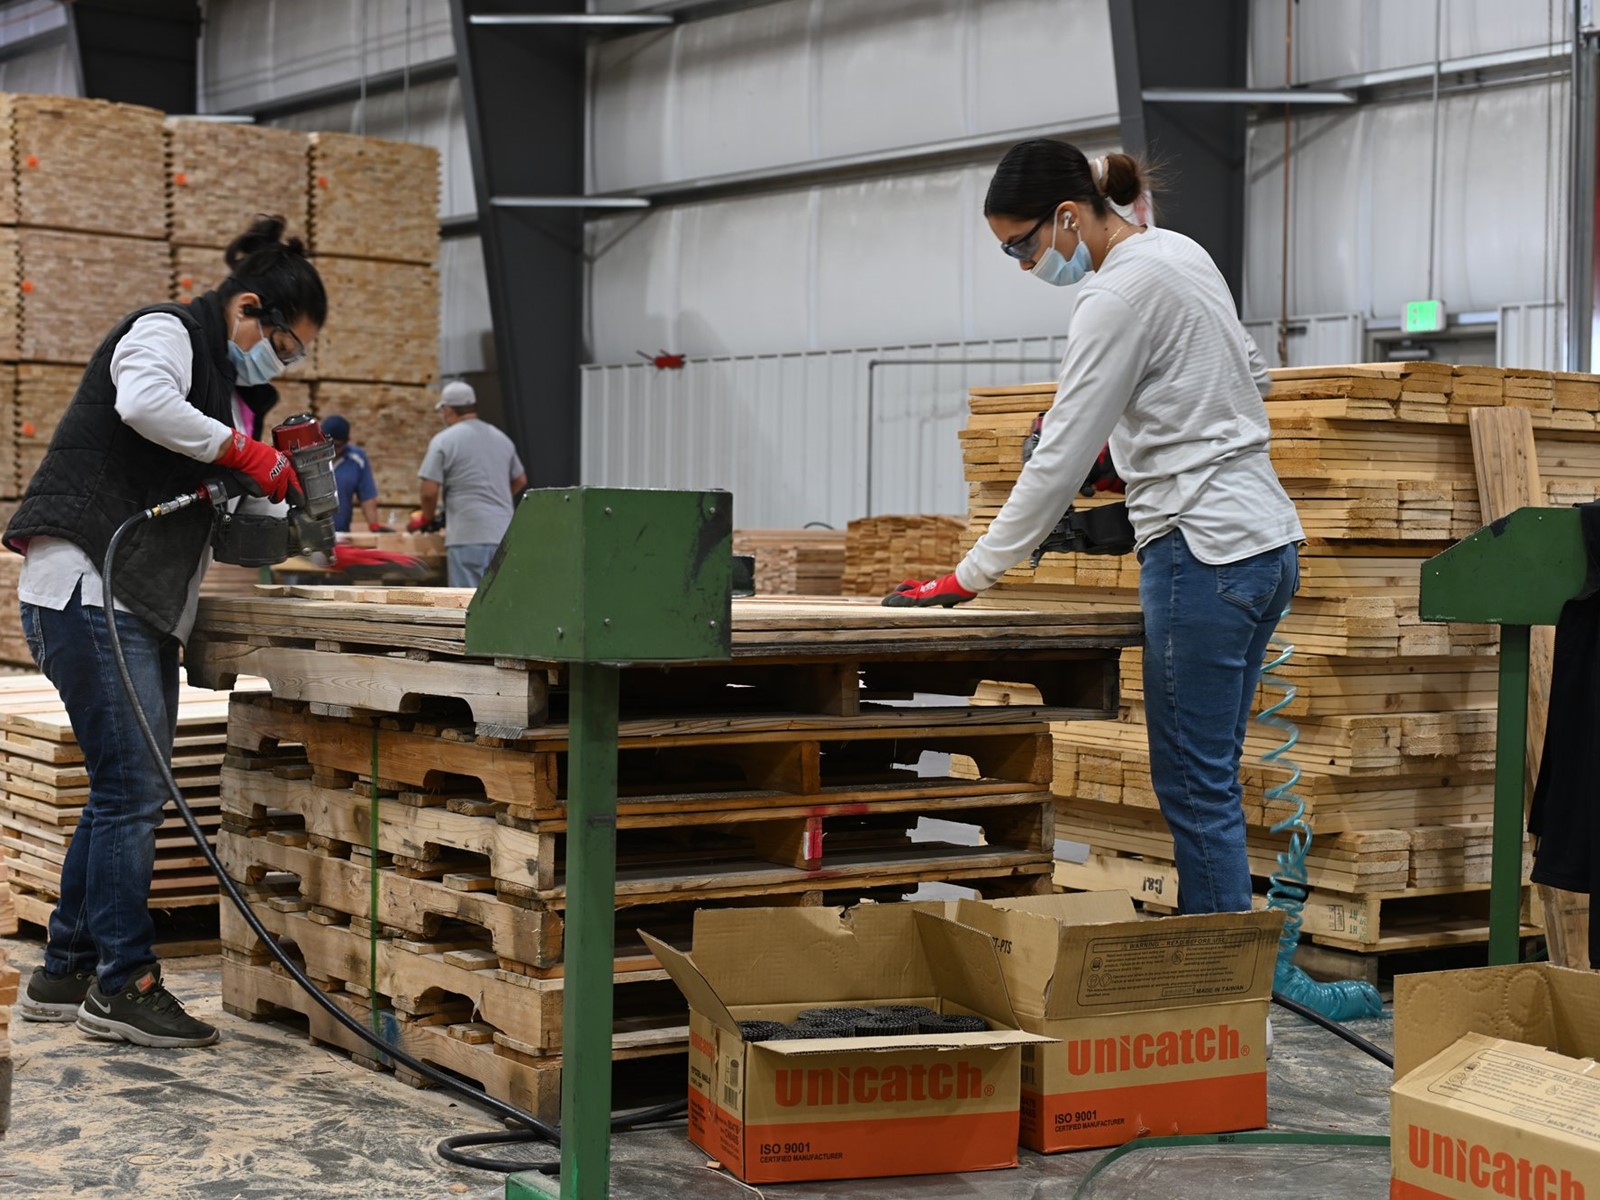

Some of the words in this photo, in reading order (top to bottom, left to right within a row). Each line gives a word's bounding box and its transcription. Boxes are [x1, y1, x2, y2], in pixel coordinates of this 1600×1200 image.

[1129, 941, 1159, 950] WARNING
[1055, 1113, 1073, 1124] ISO
[1075, 1110, 1097, 1122] 9001
[1055, 1124, 1082, 1132] CERTIFIED
[1083, 1118, 1125, 1129] MANUFACTURER
[760, 1143, 781, 1155] ISO
[784, 1142, 811, 1153] 9001
[760, 1155, 792, 1163] CERTIFIED
[793, 1152, 843, 1161] MANUFACTURER
